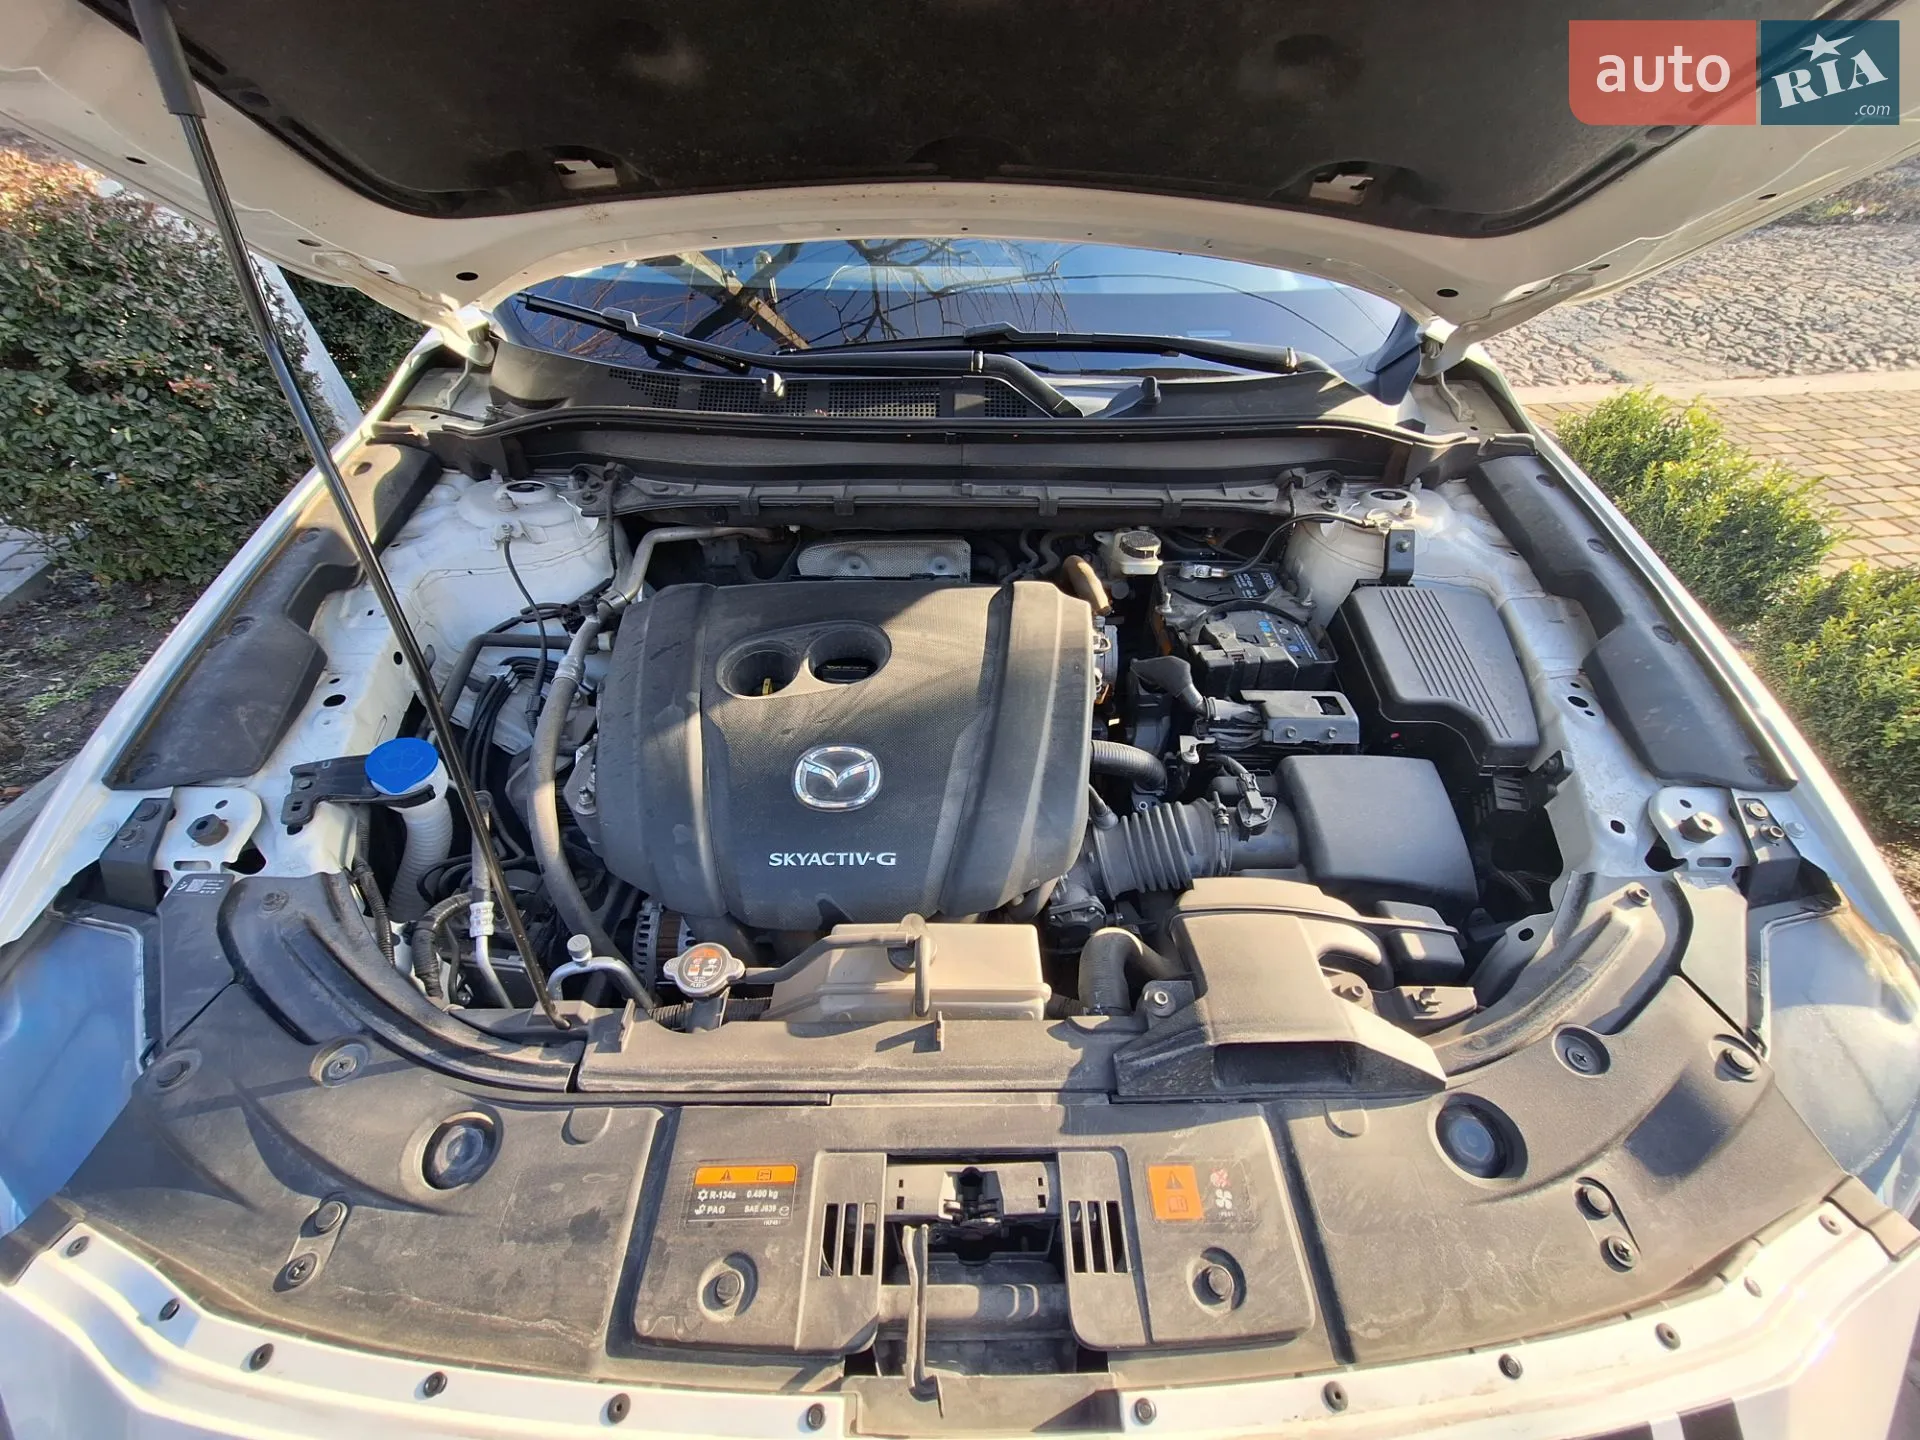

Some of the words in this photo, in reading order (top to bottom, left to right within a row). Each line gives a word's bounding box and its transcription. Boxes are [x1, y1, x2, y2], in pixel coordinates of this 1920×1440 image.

[768, 852, 897, 867] SKYACTIV-G
[709, 1189, 737, 1200] R-134a
[768, 1188, 779, 1200] kg
[706, 1205, 726, 1215] PAG
